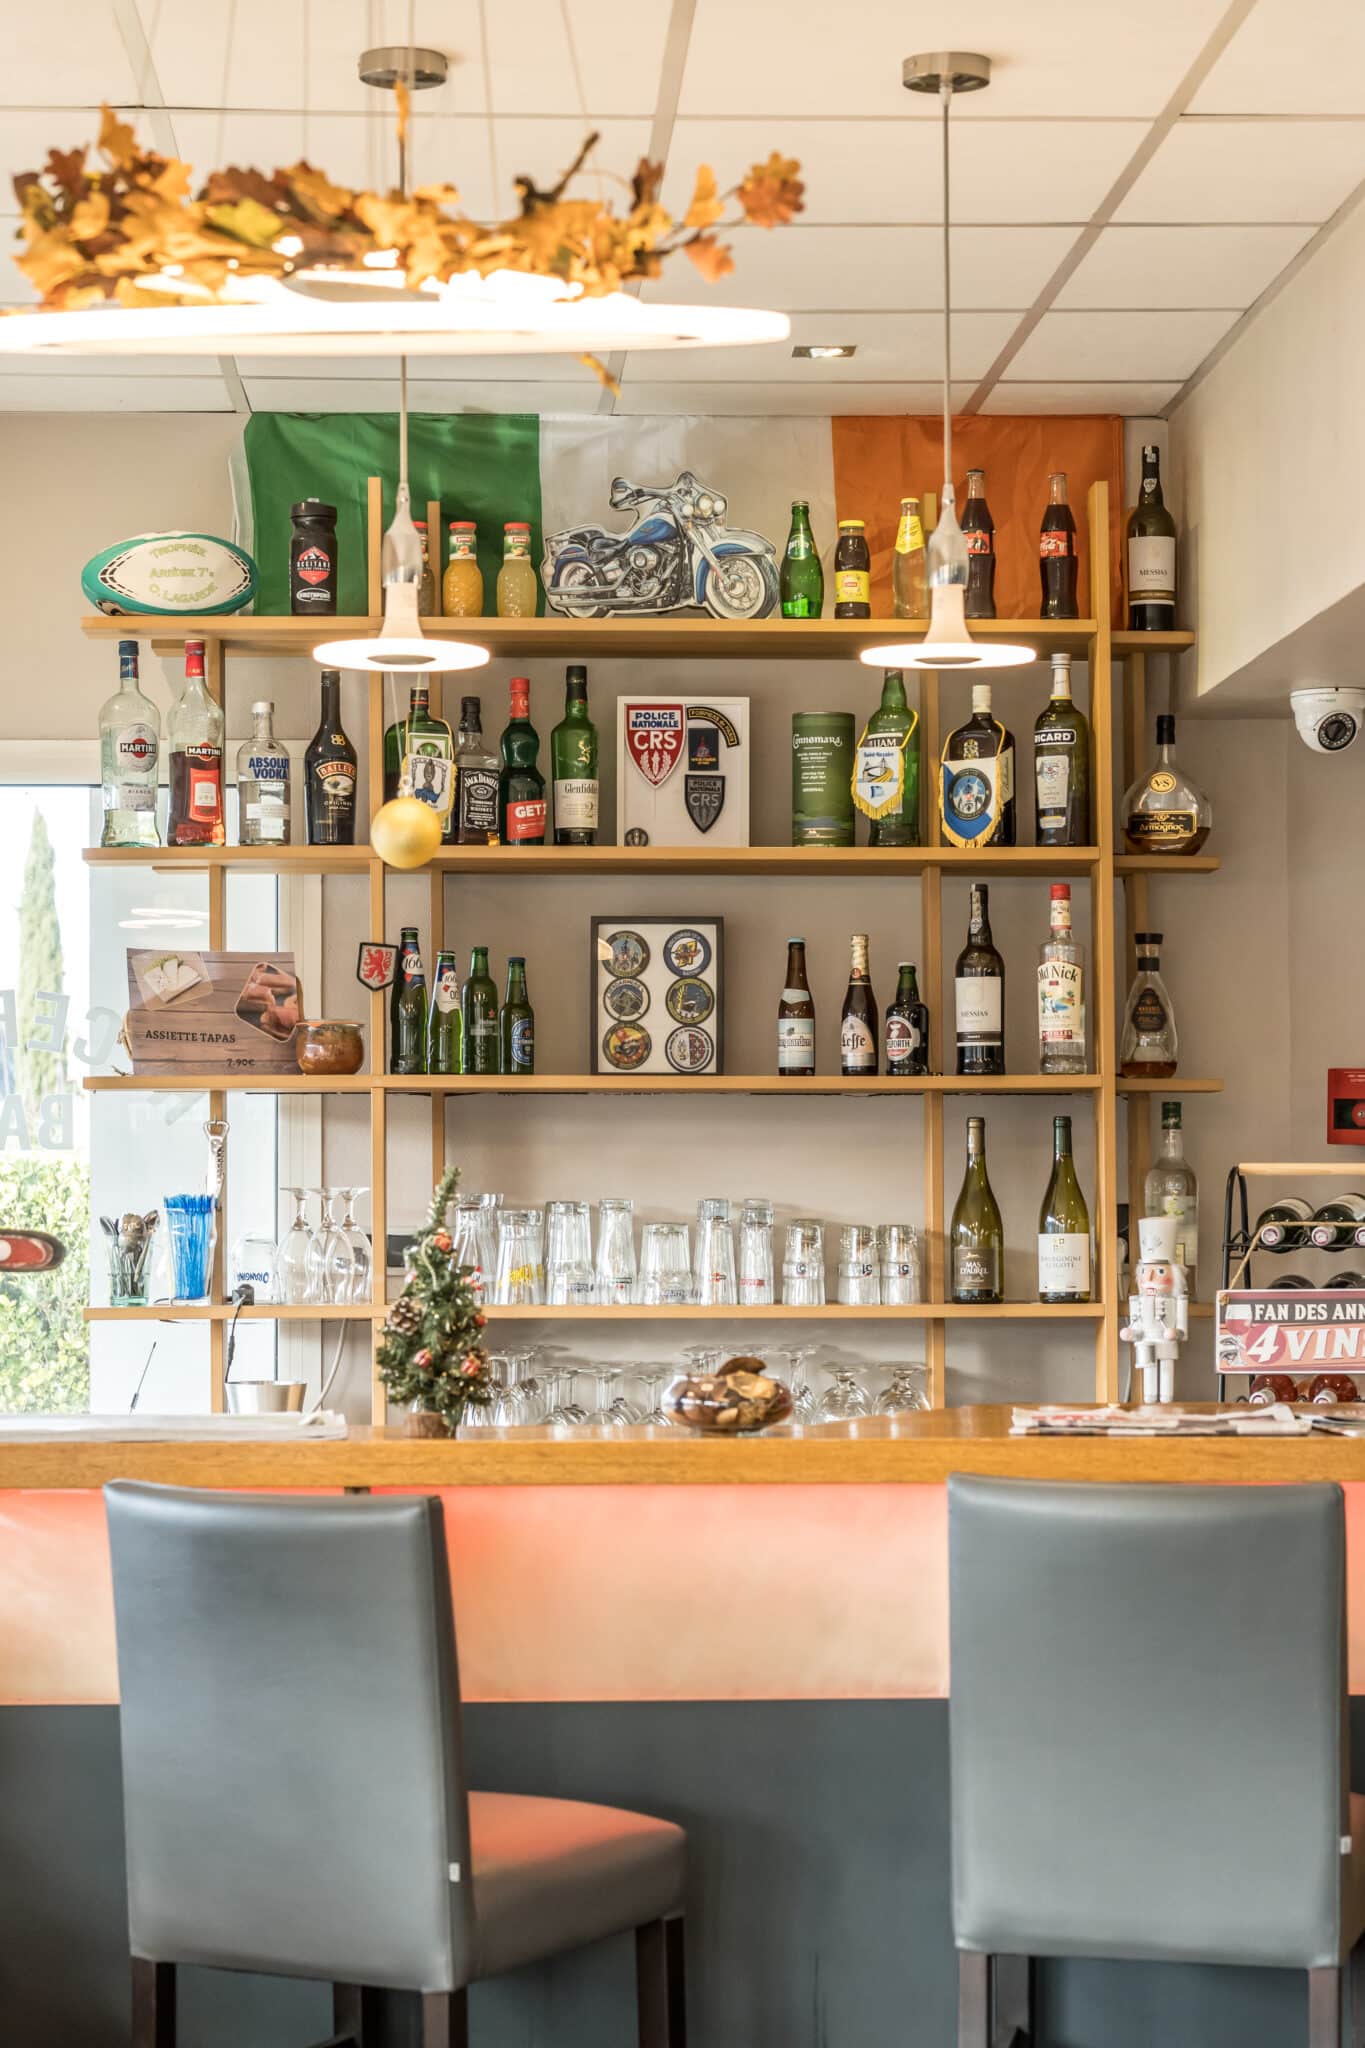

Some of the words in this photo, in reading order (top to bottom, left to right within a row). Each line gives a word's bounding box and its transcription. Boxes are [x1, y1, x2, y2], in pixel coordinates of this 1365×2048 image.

[635, 711, 675, 720] POLICE
[631, 720, 679, 728] NATIONALE
[634, 730, 677, 750] CRS
[253, 768, 288, 779] VODKA
[464, 775, 478, 788] JACK
[689, 793, 720, 806] CRS
[514, 803, 542, 819] GET
[1052, 965, 1079, 983] Nick
[145, 1029, 199, 1043] ASSIETTE
[200, 1032, 236, 1044] TAPAS
[1254, 1303, 1289, 1321] FAN
[1294, 1303, 1328, 1321] DES
[1247, 1324, 1280, 1363] 4
[1284, 1327, 1365, 1361] VIN
